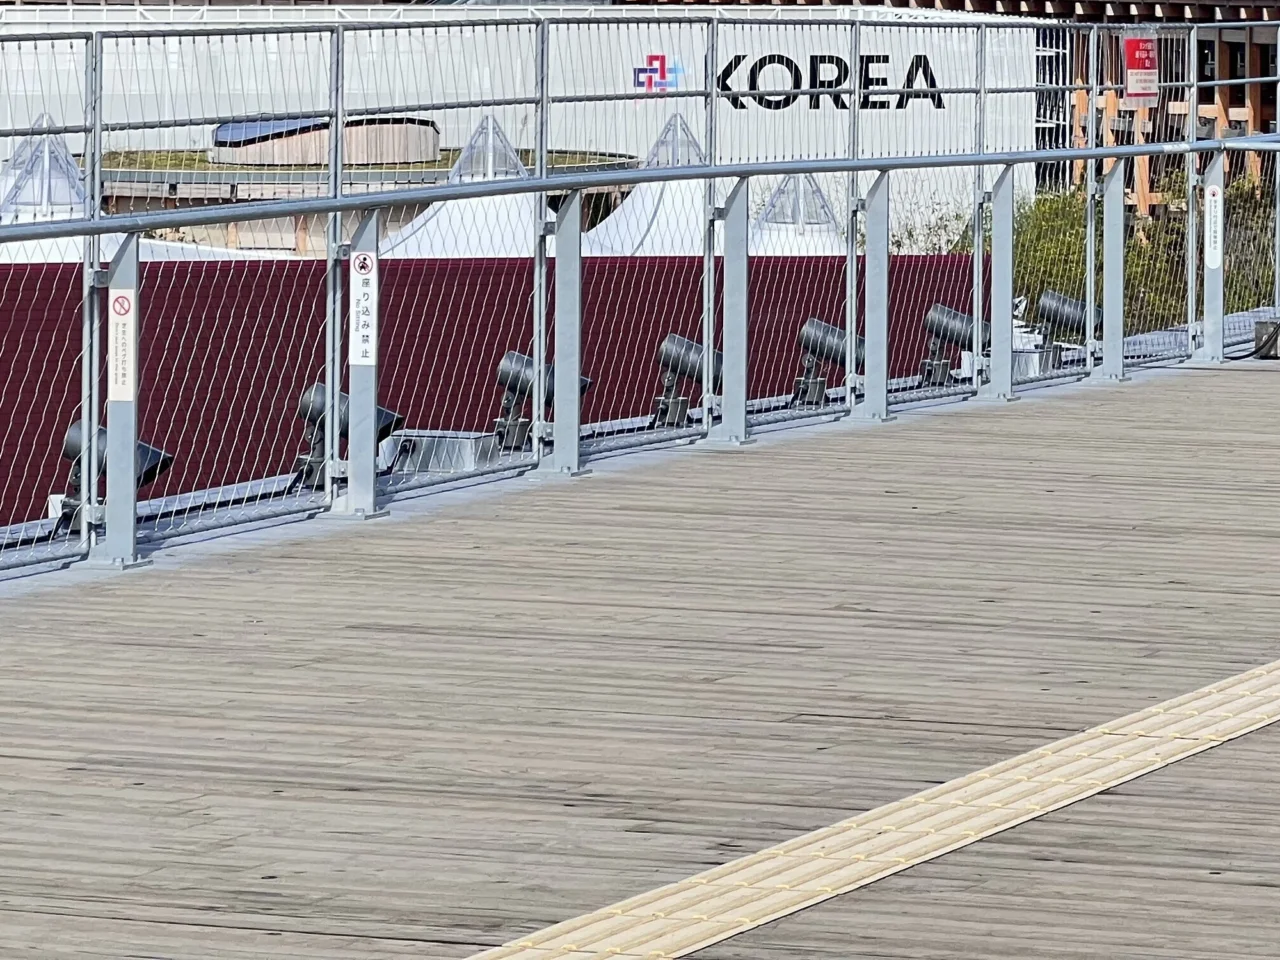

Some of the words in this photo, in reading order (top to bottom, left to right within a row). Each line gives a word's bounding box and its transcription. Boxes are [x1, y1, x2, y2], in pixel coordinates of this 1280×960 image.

[705, 54, 945, 110] KOREA
[355, 299, 361, 308] No
[361, 278, 370, 358] 座り込み禁止
